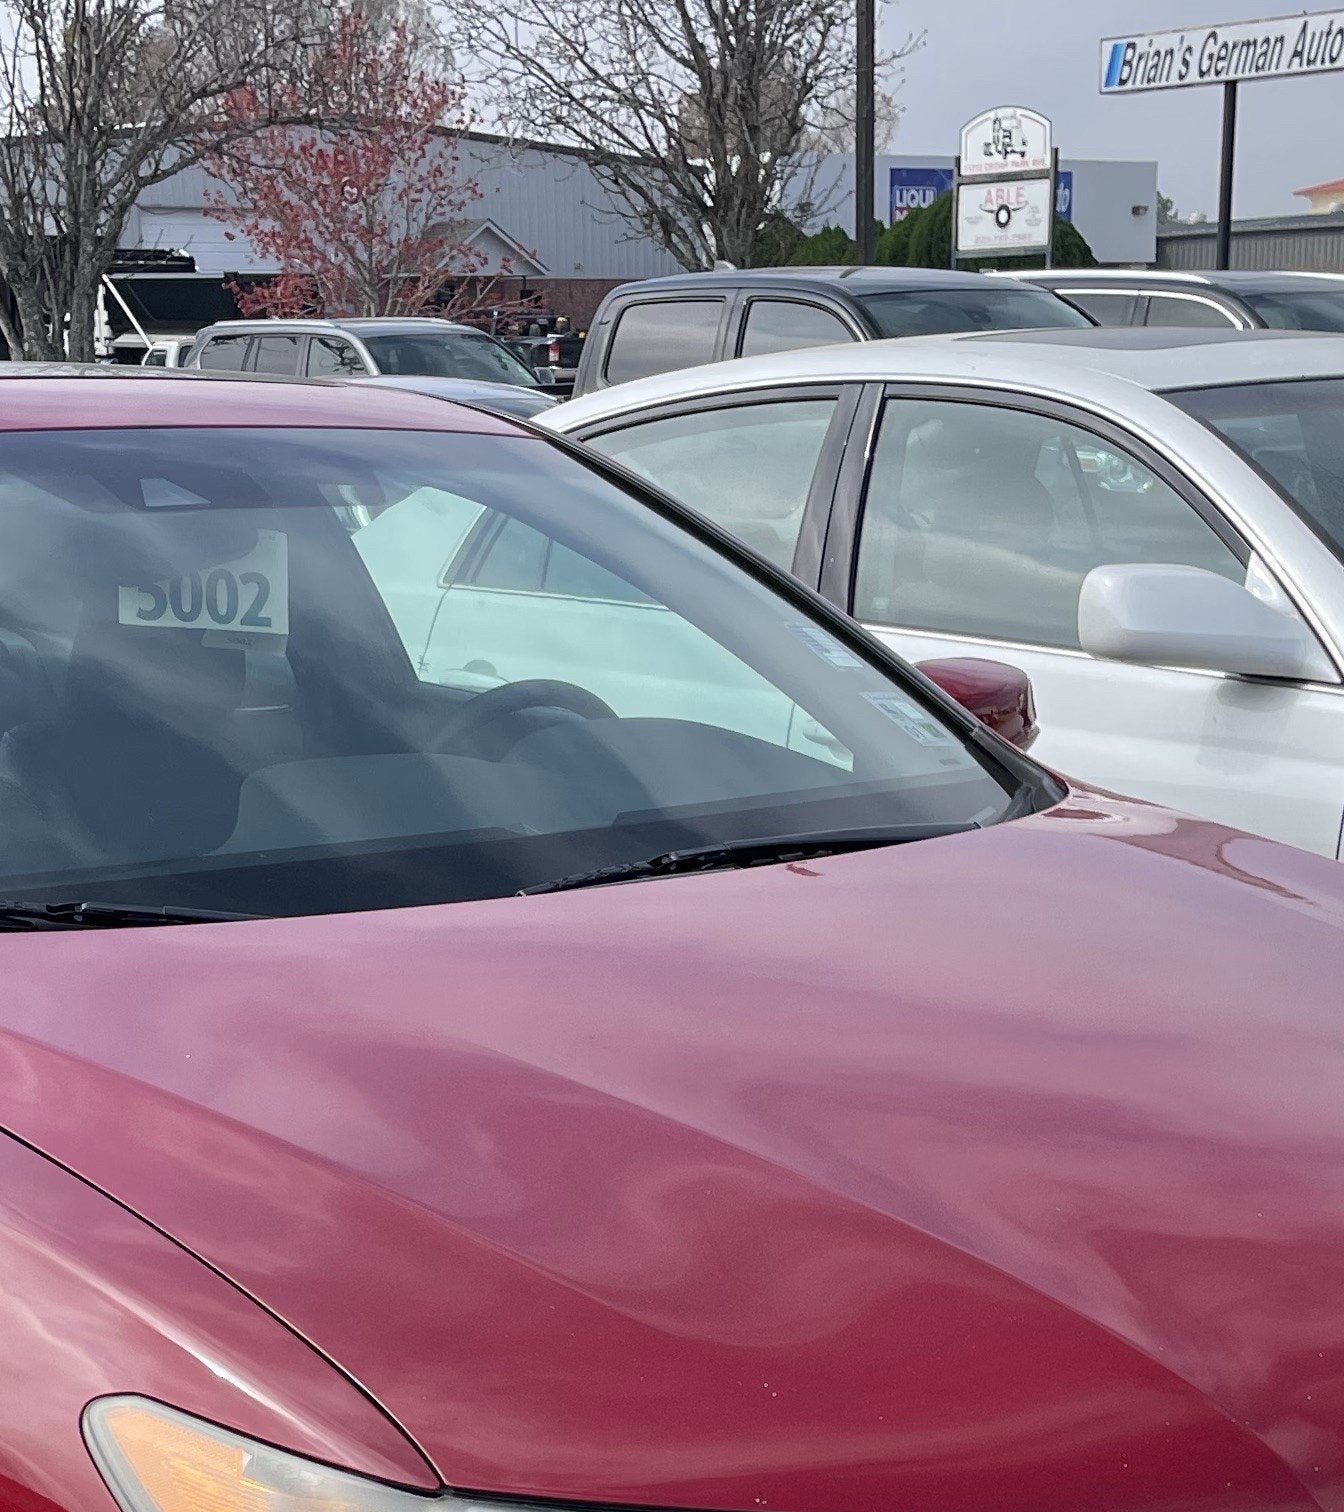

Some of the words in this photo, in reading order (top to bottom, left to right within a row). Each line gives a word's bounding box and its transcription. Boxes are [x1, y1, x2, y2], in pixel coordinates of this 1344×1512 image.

[1119, 35, 1193, 87] Brian's
[1198, 30, 1285, 79] German
[1288, 19, 1344, 70] Auto
